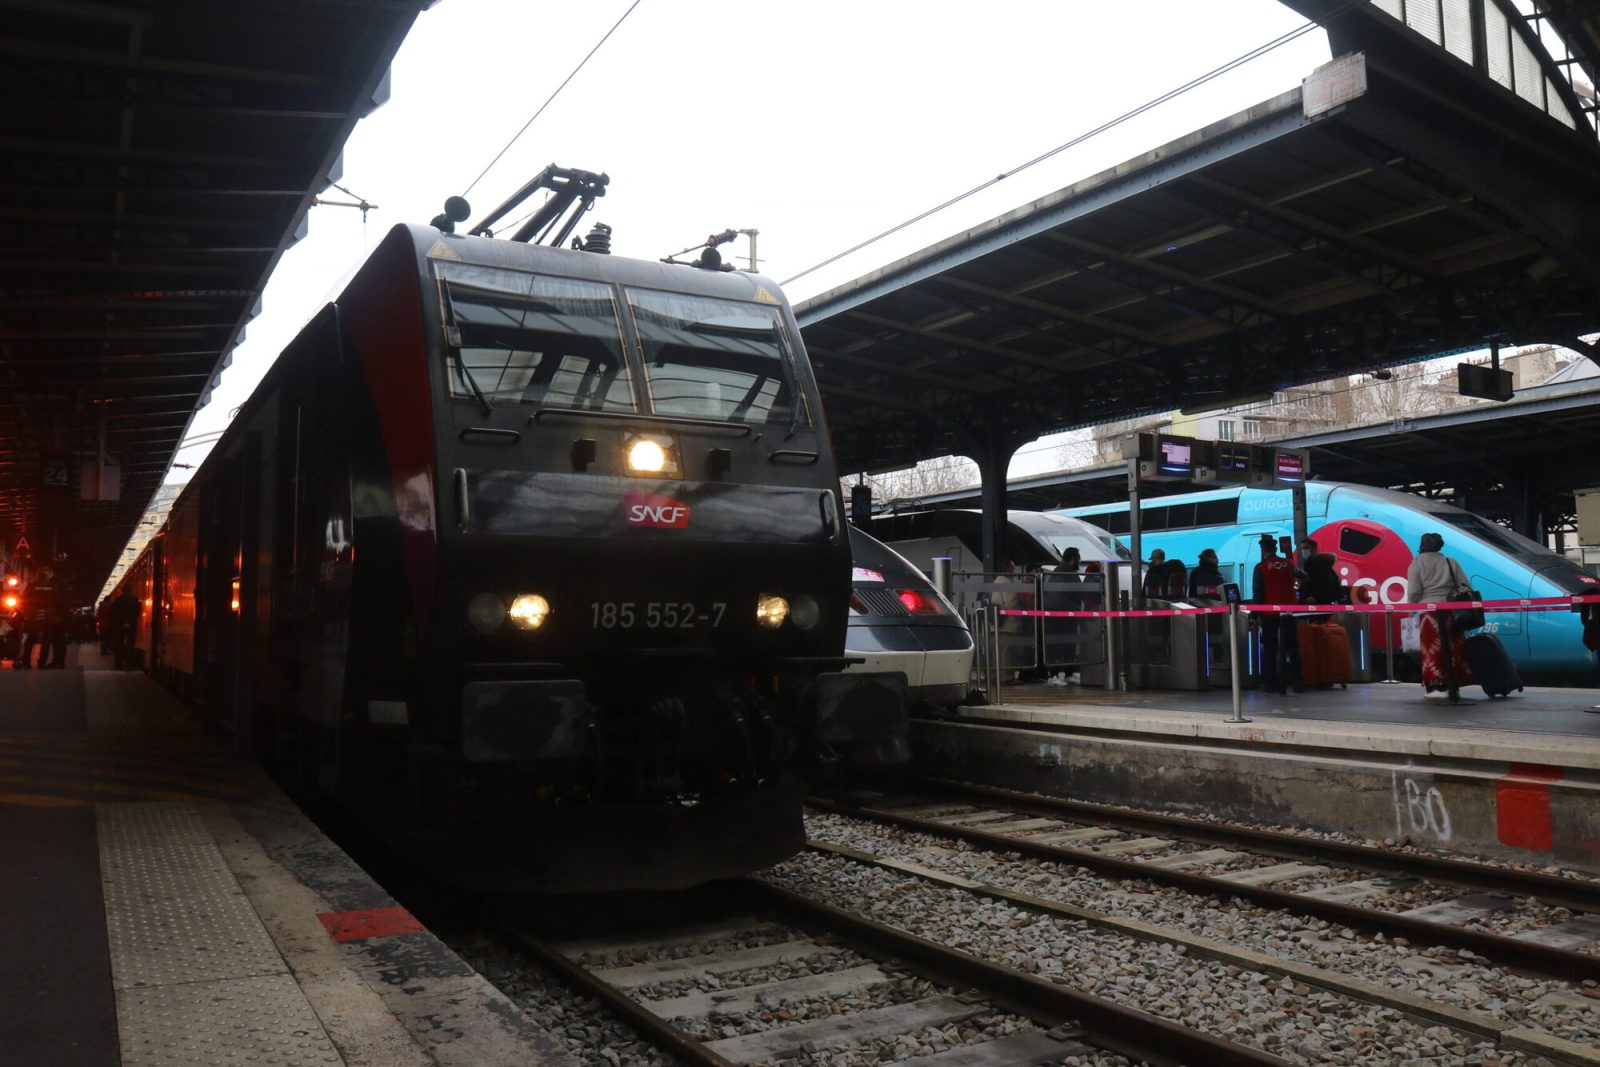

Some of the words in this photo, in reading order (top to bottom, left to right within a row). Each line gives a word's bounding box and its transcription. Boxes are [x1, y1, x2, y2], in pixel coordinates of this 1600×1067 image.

[43, 466, 69, 482] 24
[629, 504, 687, 523] SNCF
[16, 535, 30, 550] A
[590, 602, 635, 629] 185
[646, 602, 727, 629] 552-7
